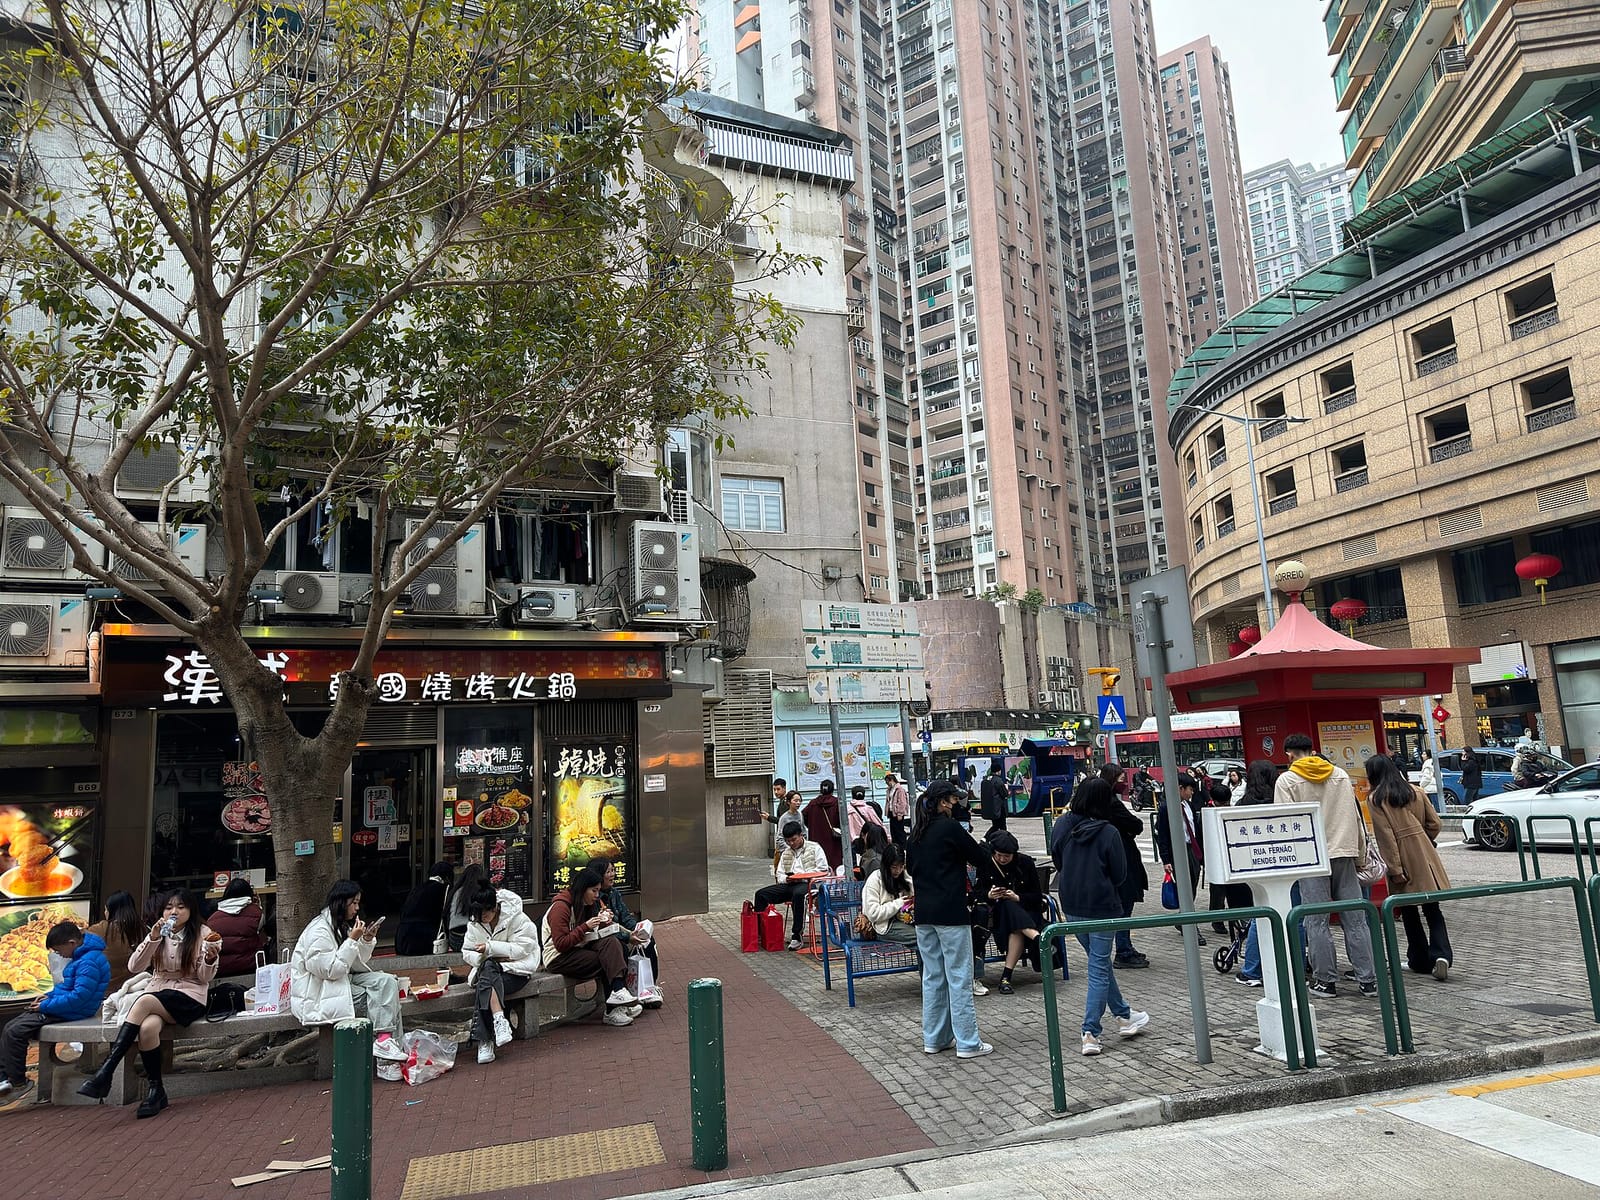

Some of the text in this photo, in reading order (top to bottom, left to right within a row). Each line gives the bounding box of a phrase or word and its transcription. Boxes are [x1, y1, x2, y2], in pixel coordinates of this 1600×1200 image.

[1275, 570, 1304, 582] CORREIO
[78, 784, 97, 792] 669
[1240, 822, 1301, 836] 飛能便度街
[1269, 845, 1293, 854] FERNÃO
[1252, 855, 1297, 865] MENDES PINTO
